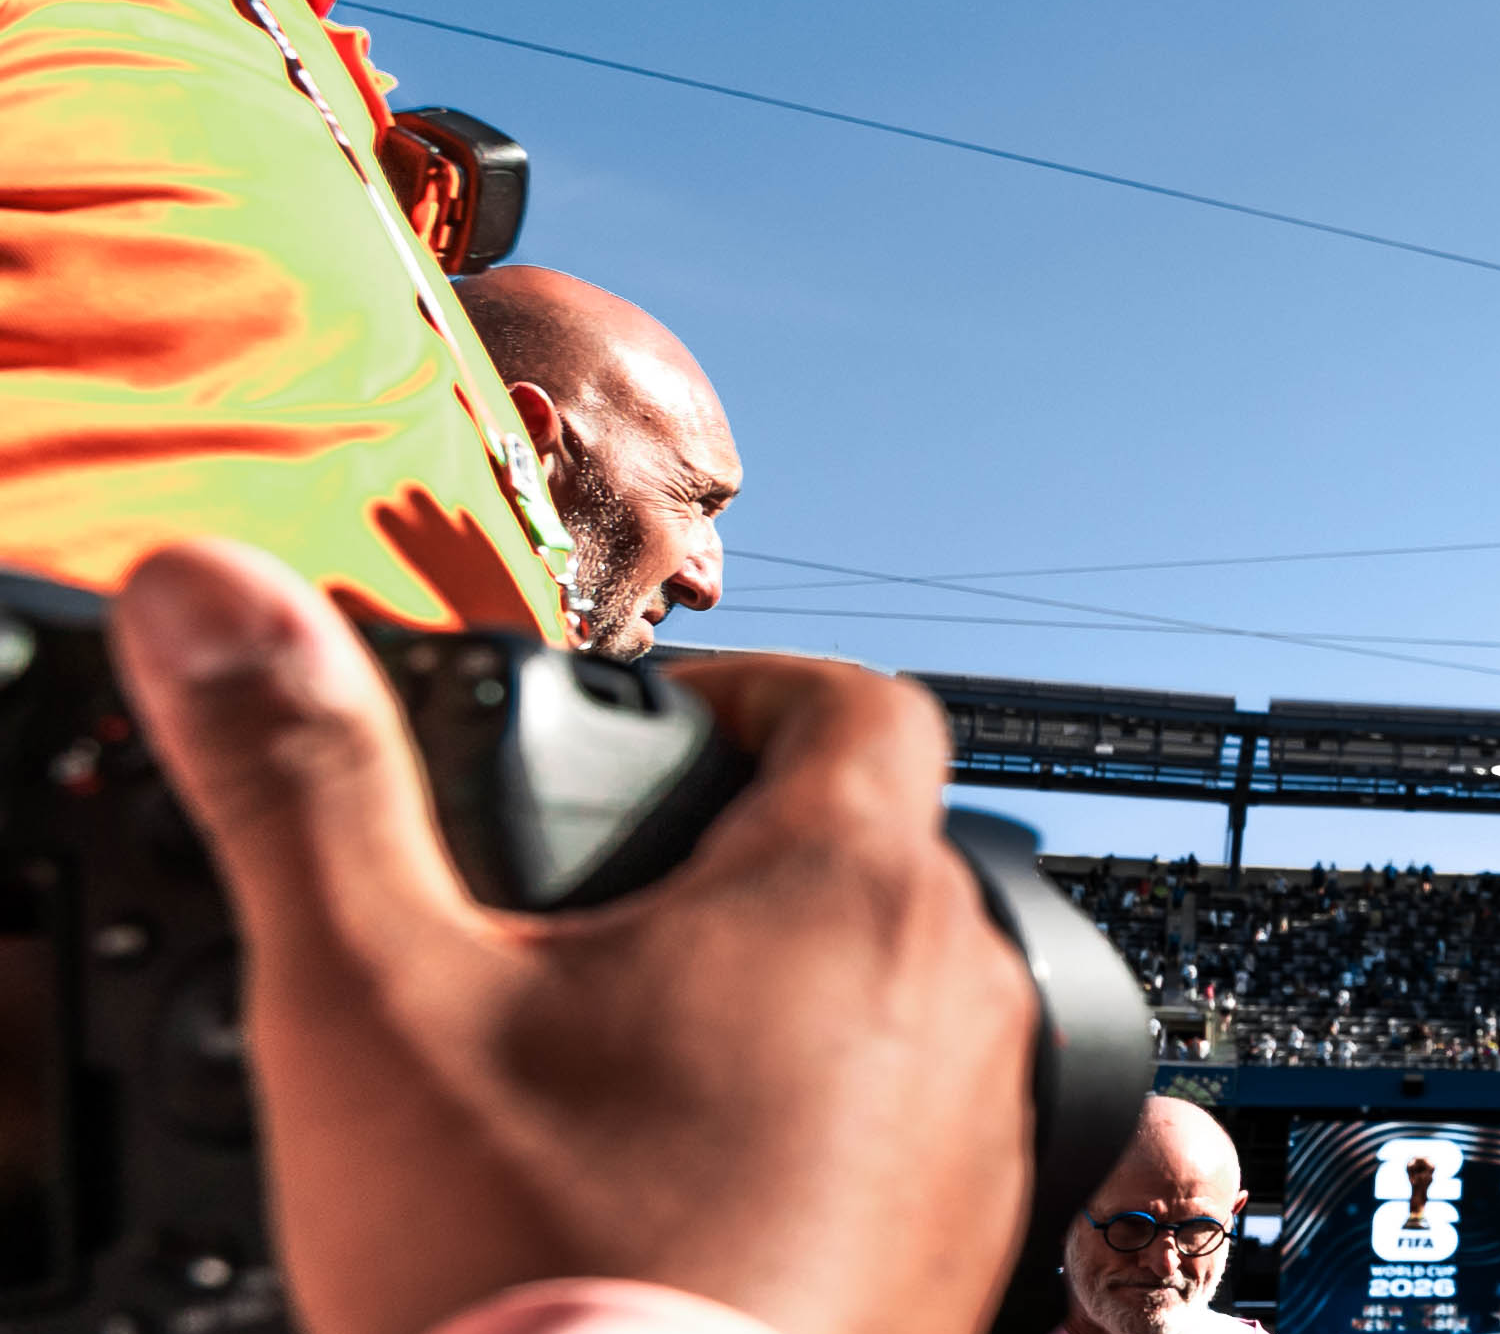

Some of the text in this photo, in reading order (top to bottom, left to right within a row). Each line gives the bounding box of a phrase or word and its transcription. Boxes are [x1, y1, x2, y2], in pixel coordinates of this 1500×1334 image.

[1398, 1237, 1435, 1249] FIFA
[1370, 1264, 1458, 1278] WORLD CUP
[1369, 1278, 1456, 1297] 2026
